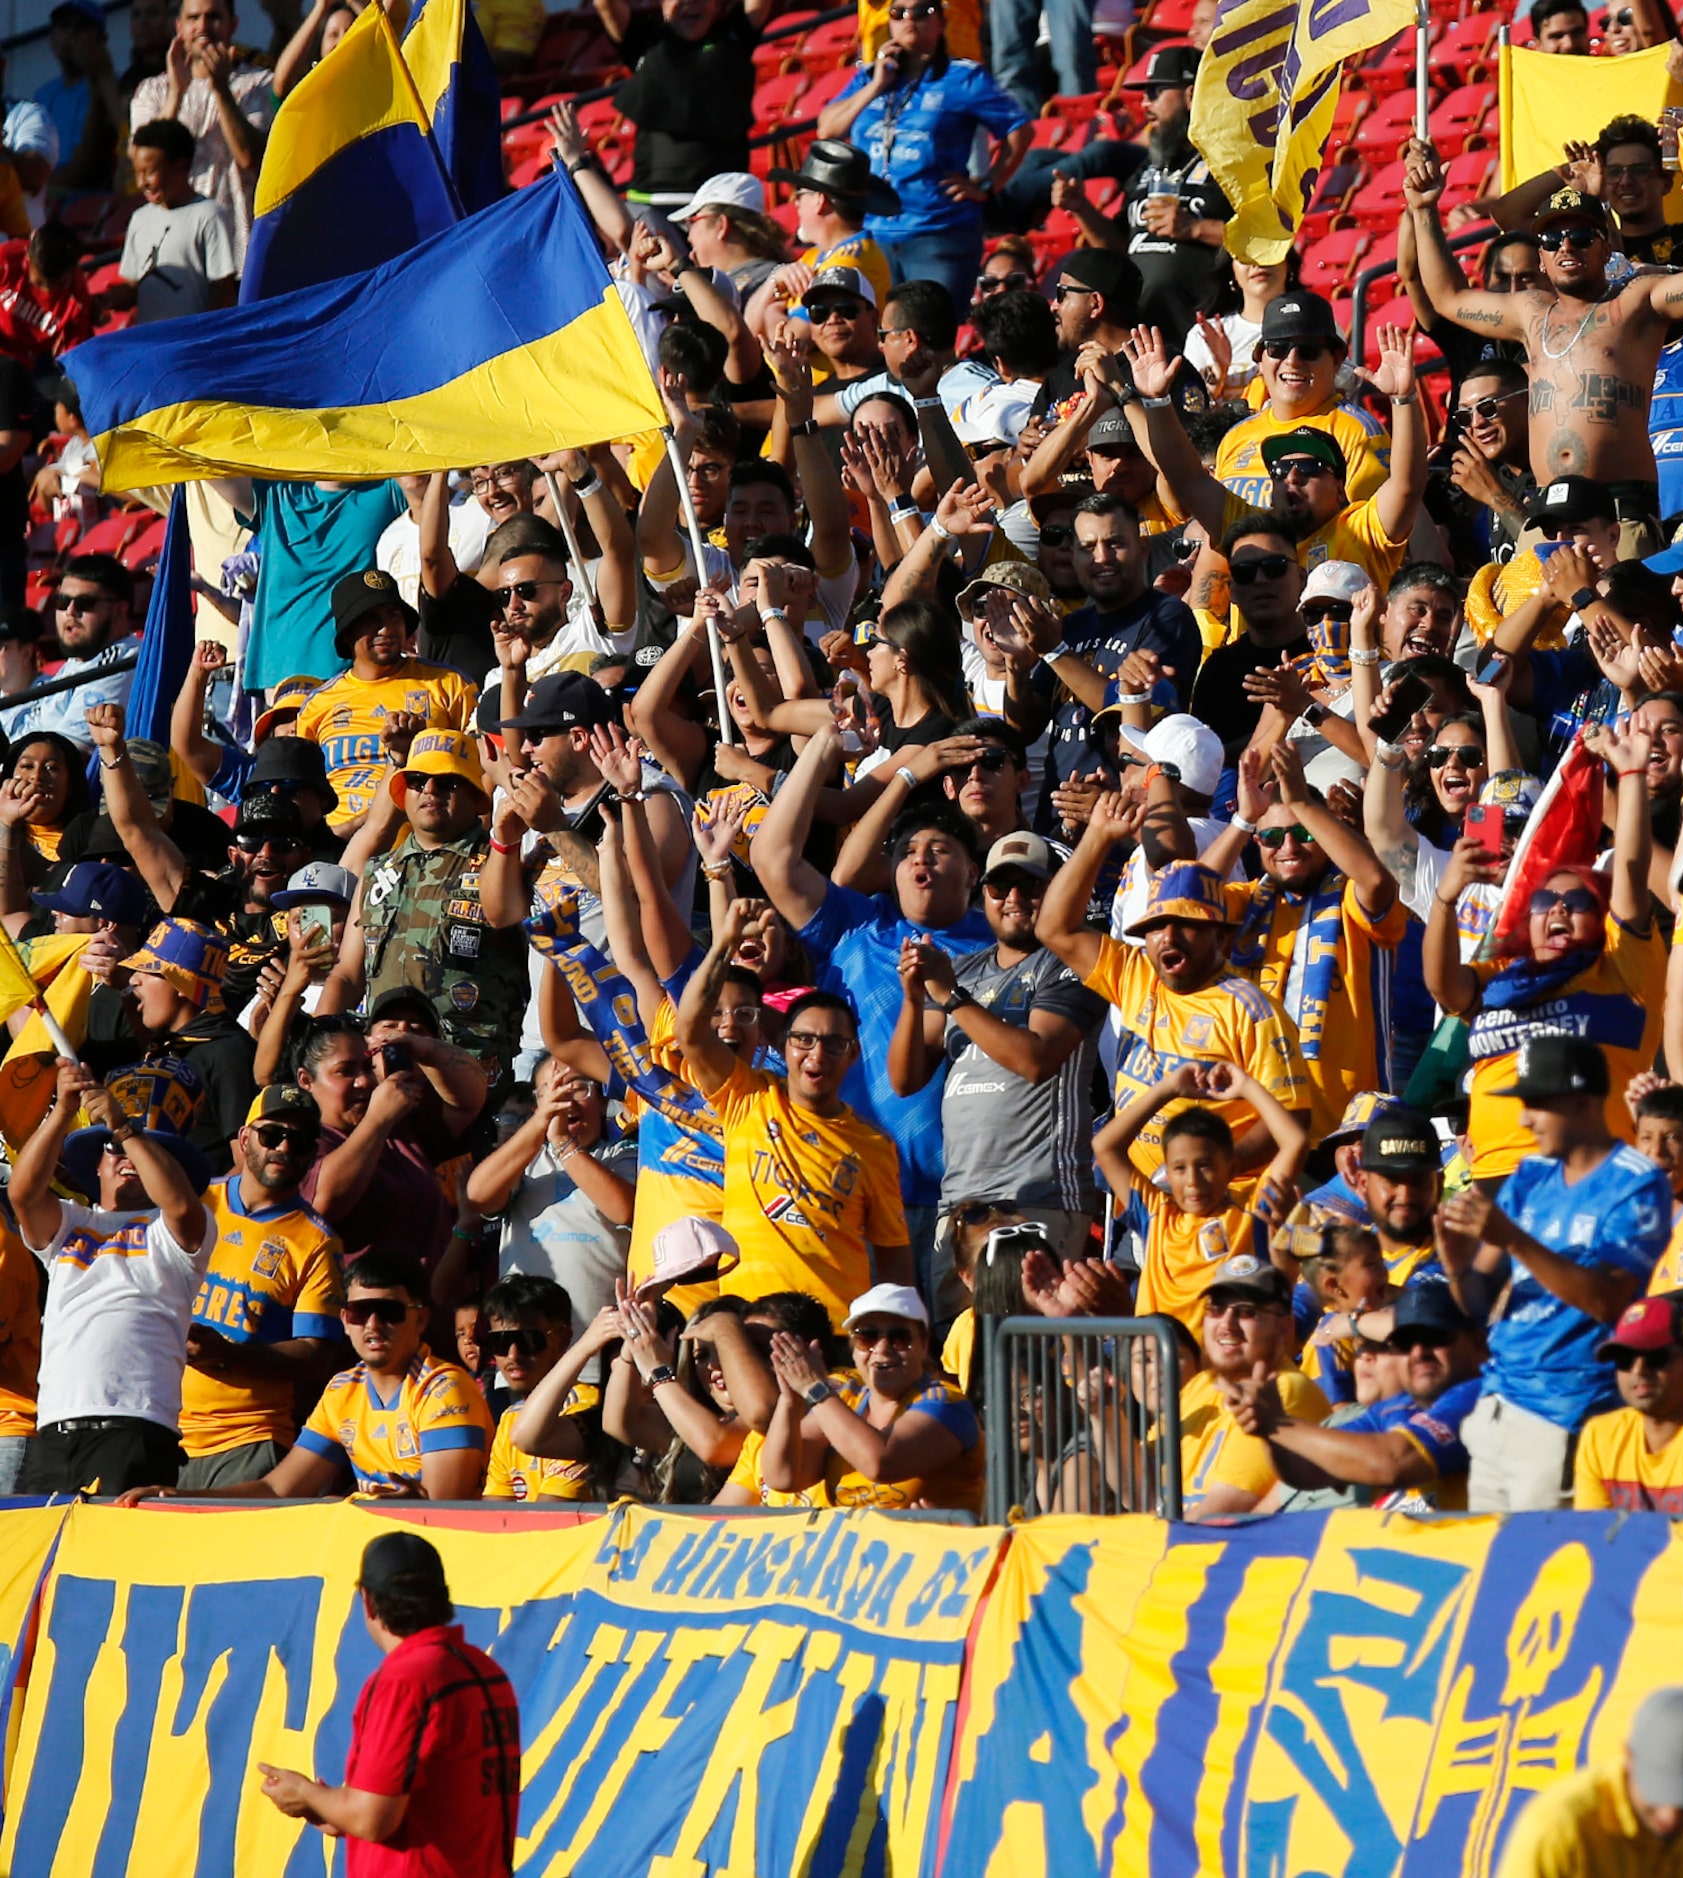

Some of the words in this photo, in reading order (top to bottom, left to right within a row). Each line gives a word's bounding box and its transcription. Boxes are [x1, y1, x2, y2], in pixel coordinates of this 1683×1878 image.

[1456, 306, 1504, 327] kimberly
[1098, 419, 1132, 434] TIGRE
[1104, 636, 1127, 655] LOS
[956, 1082, 1006, 1095] CEMEX
[1379, 1138, 1426, 1156] SAVAGE
[684, 1154, 725, 1175] CEM
[192, 1282, 265, 1333] GRES
[834, 1483, 907, 1507] GRES
